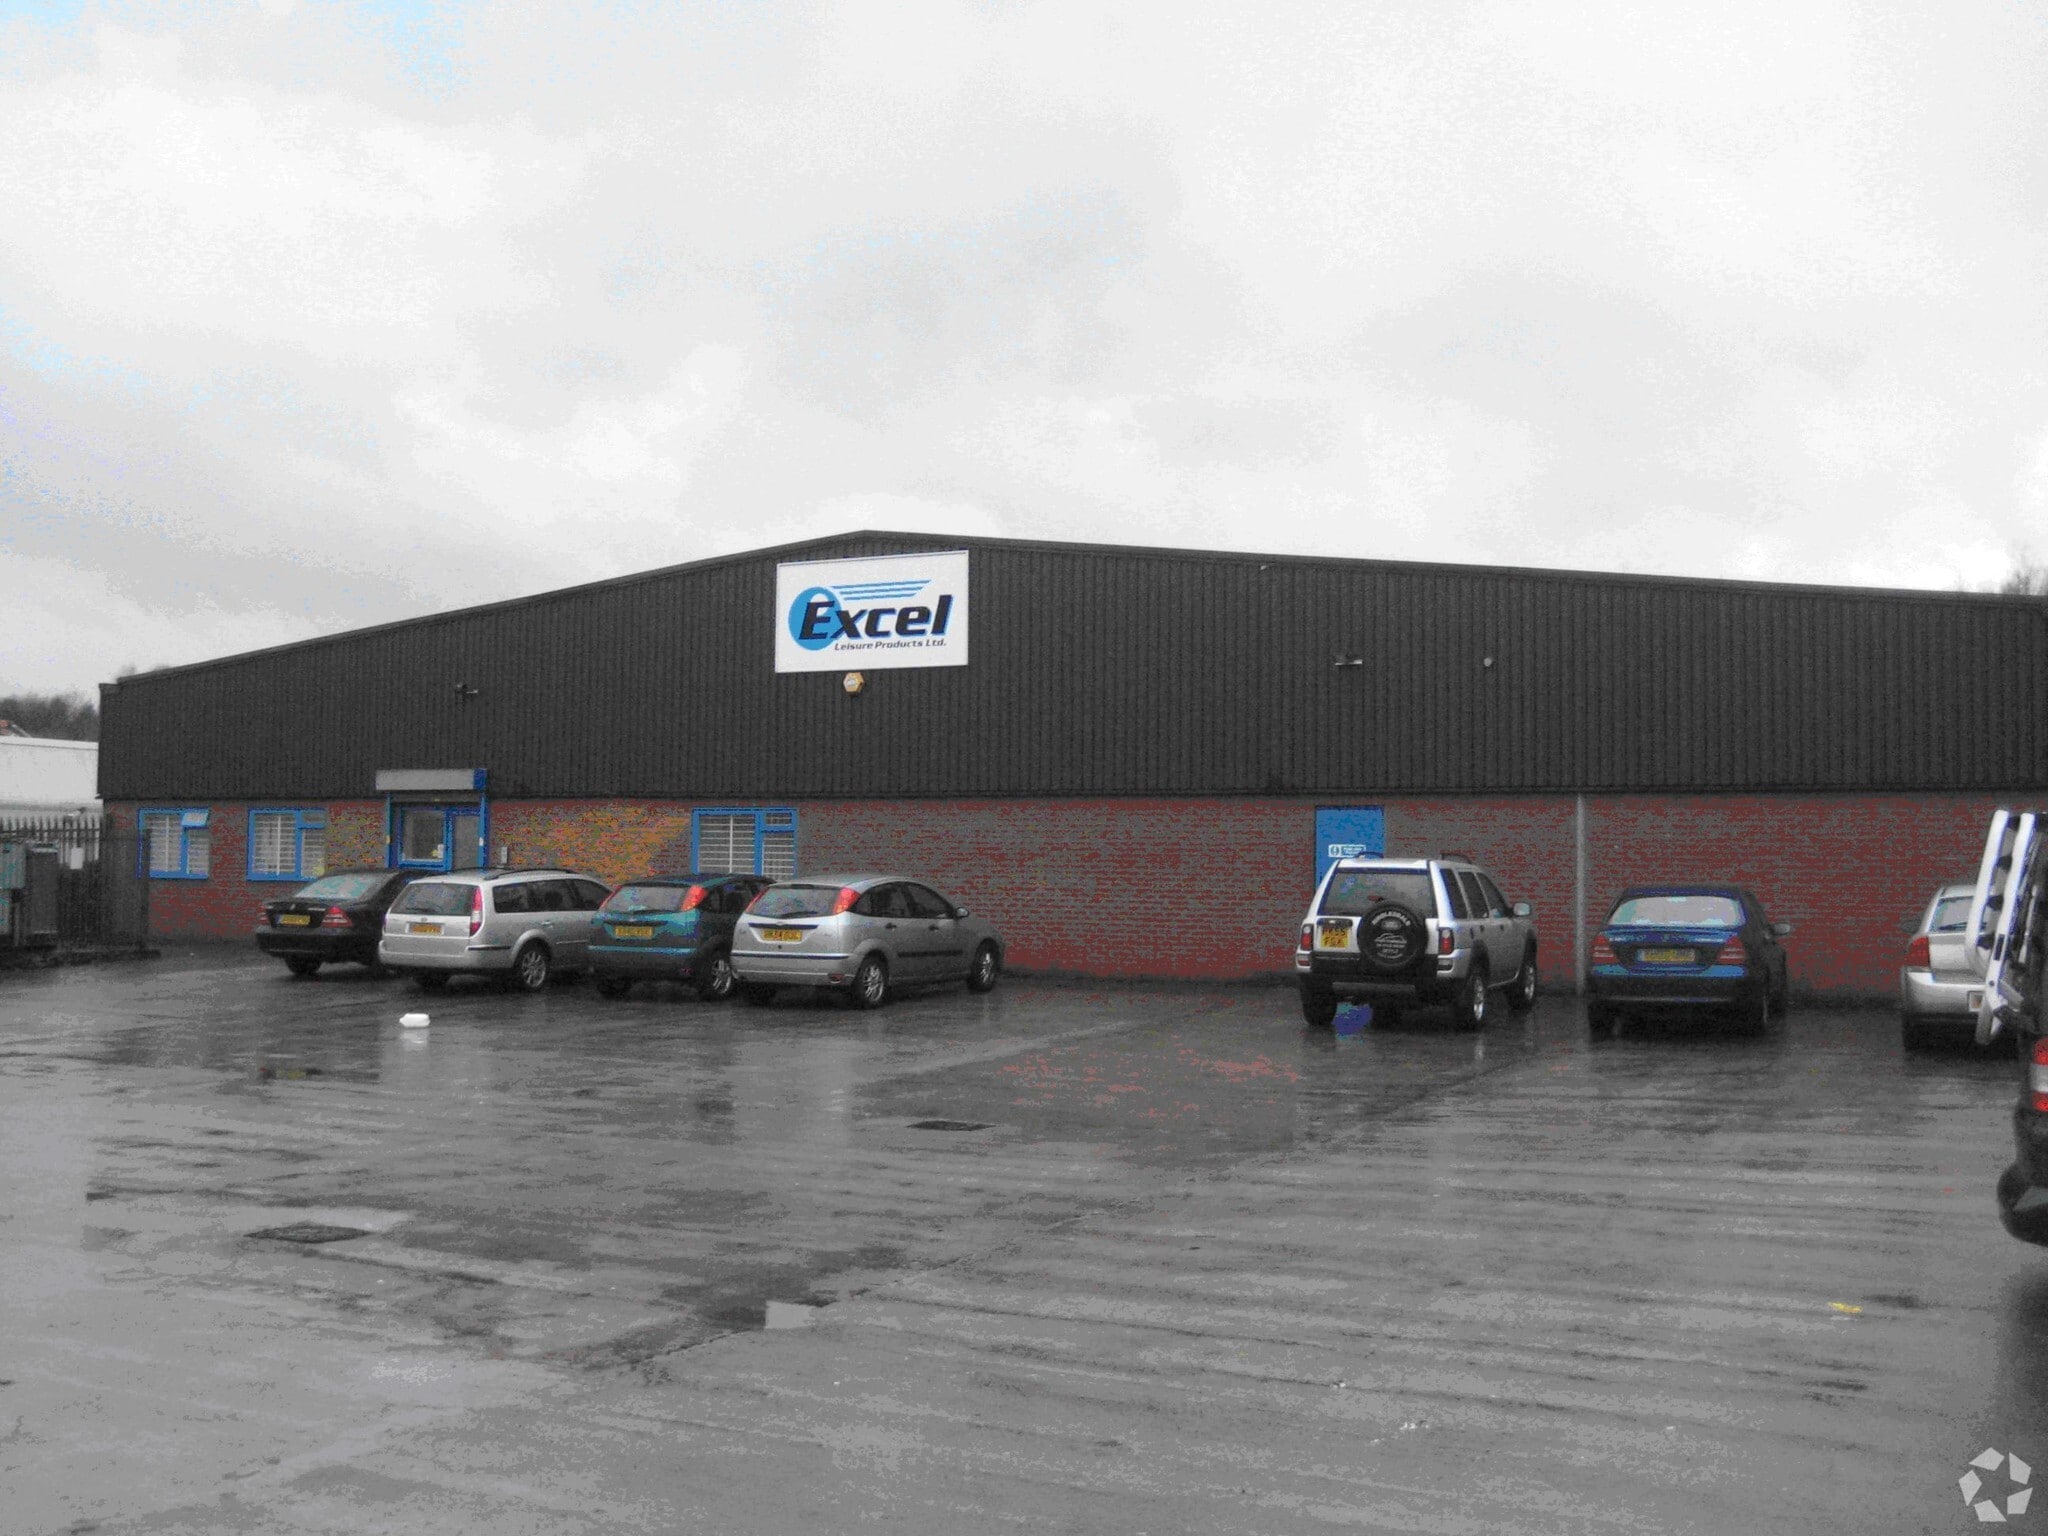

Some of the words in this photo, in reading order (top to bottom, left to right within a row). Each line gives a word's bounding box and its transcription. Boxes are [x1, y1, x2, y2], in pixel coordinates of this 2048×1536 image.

[799, 594, 953, 640] Excel
[834, 643, 873, 651] Leisure
[875, 640, 923, 649] Products
[925, 638, 946, 647] Ltd.
